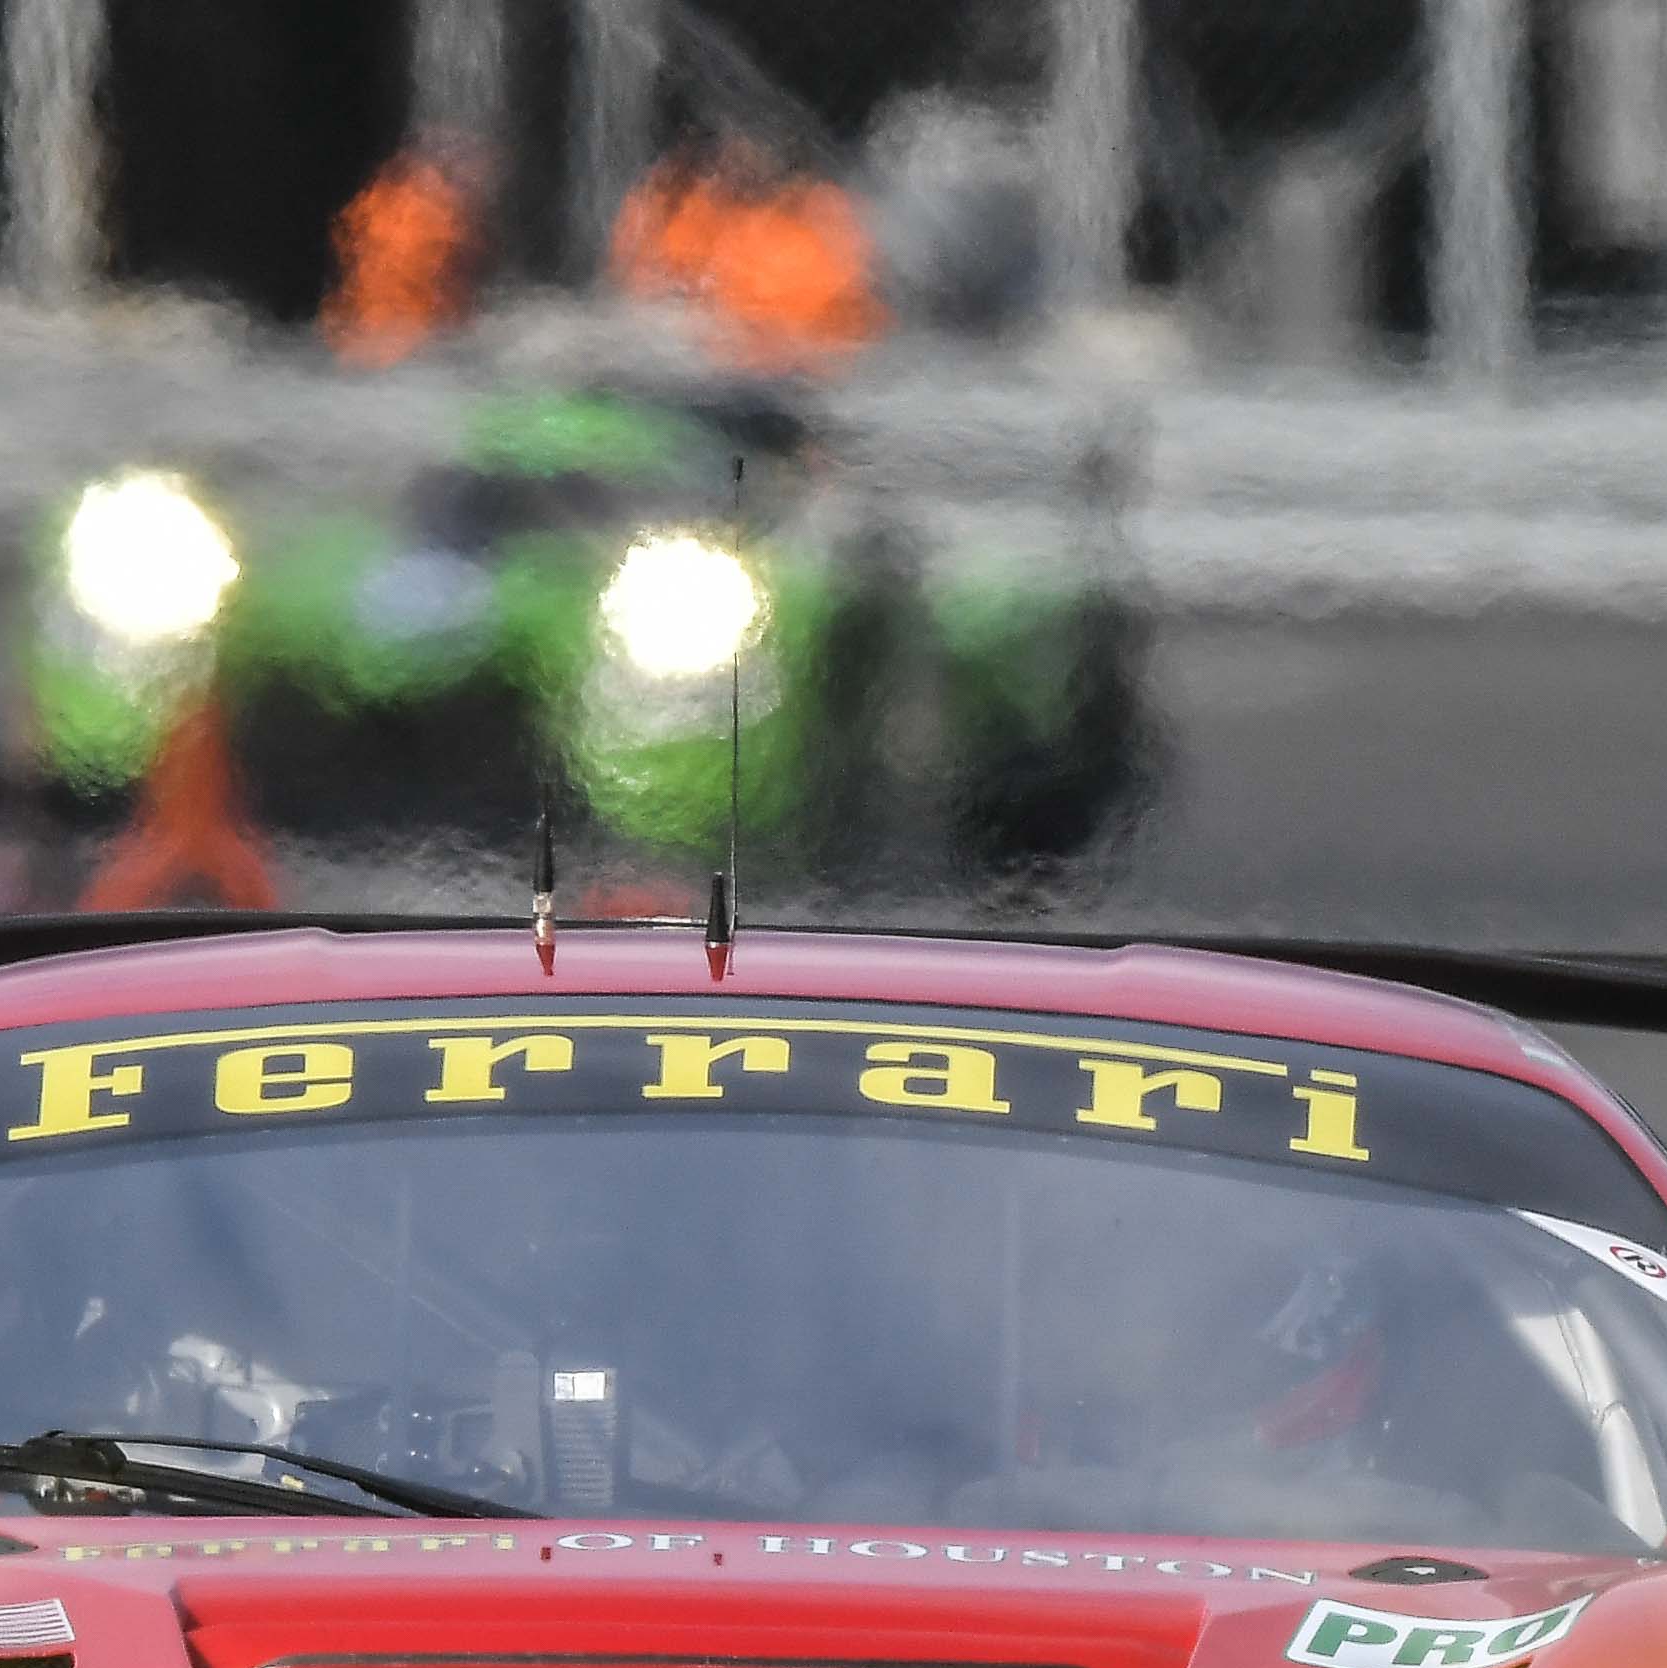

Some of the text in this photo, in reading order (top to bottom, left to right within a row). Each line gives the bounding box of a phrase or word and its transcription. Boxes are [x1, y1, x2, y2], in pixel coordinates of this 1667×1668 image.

[7, 1014, 1371, 1162] Ferrari
[555, 1531, 704, 1551] OF
[756, 1535, 1316, 1587] HOUSTON
[1306, 1608, 1570, 1666] PRO
